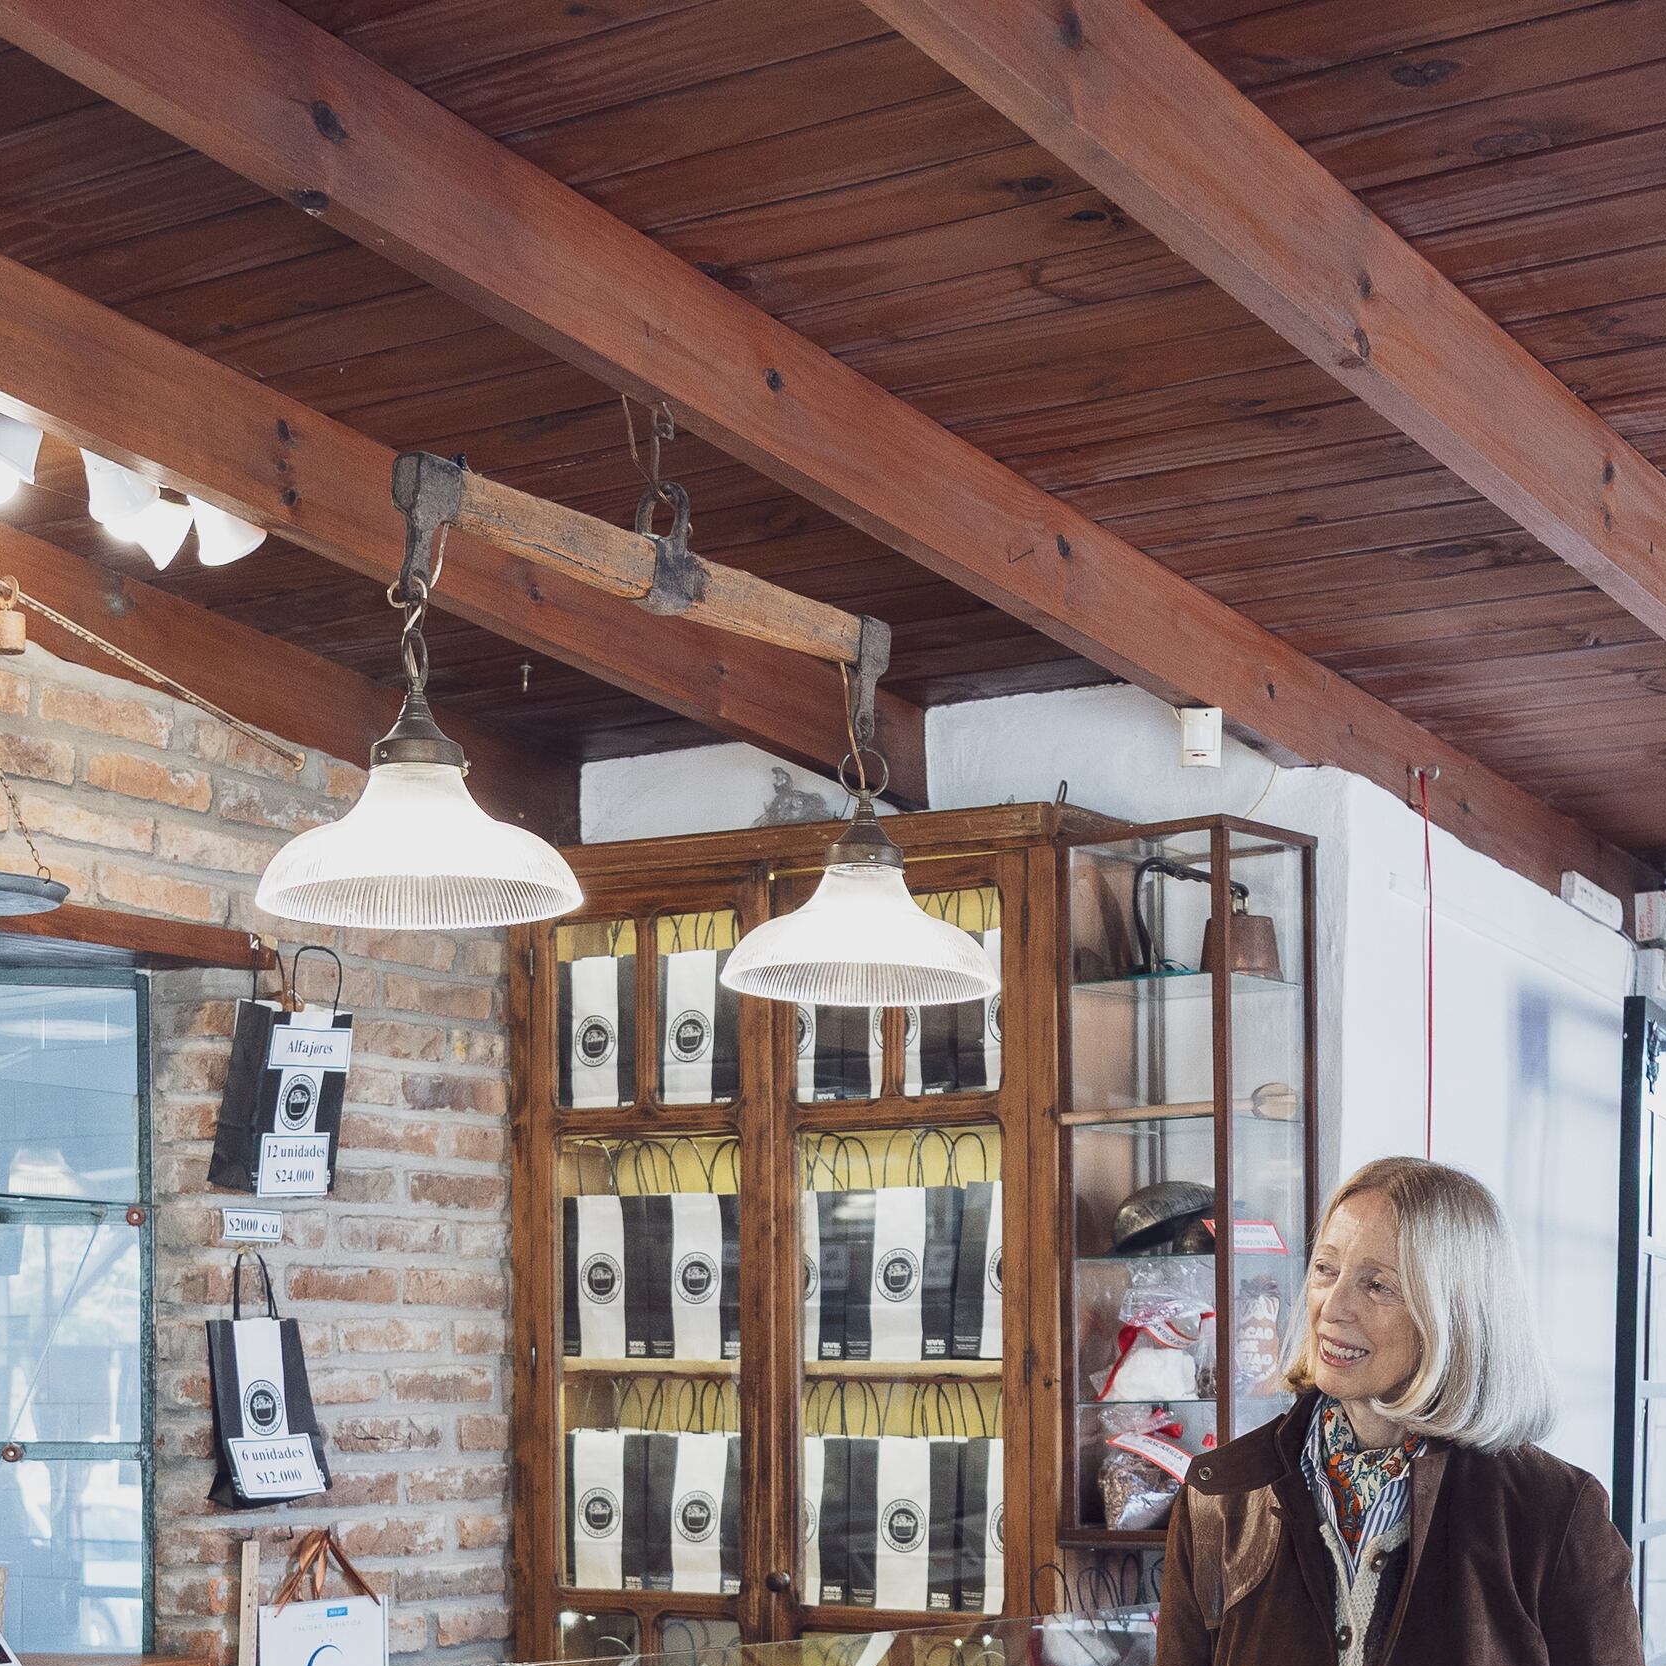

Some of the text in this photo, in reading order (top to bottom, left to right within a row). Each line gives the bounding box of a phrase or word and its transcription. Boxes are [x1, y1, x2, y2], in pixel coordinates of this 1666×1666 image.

[286, 1039, 334, 1057] Alfajores
[267, 1144, 326, 1158] 12 unidades
[275, 1169, 315, 1183] $24.000
[229, 1217, 279, 1233] $2000 c/u
[241, 1446, 304, 1461] 6 unidades
[256, 1468, 302, 1485] $12.000
